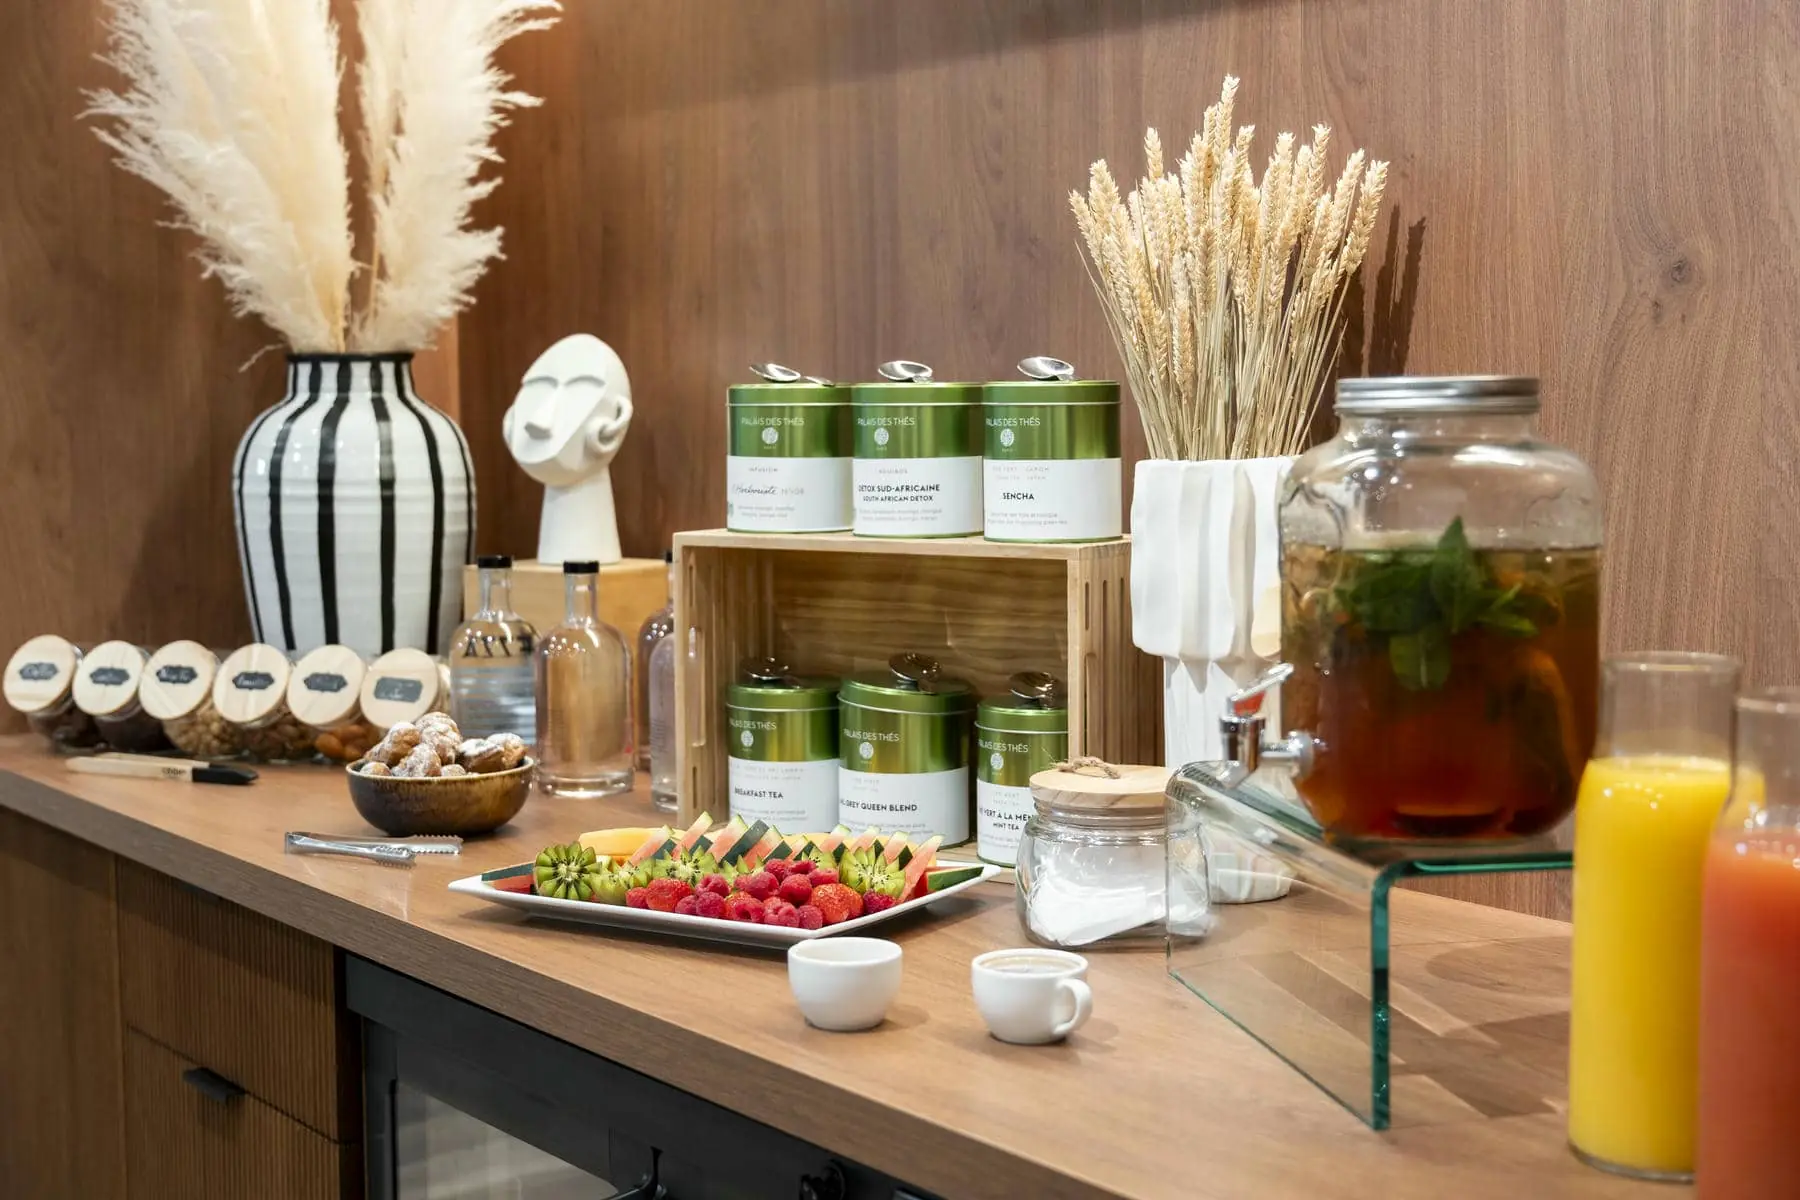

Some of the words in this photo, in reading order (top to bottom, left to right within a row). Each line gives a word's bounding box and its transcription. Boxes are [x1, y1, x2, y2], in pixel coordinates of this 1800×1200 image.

[765, 416, 782, 426] DES
[877, 416, 893, 426] DES
[893, 415, 915, 426] THÉS
[1003, 417, 1018, 427] DES
[1019, 416, 1041, 427] THÉS
[877, 483, 941, 493] SUD-AFRICAINE
[910, 494, 934, 502] DETOX
[1002, 492, 1035, 501] SENCHA
[862, 730, 877, 740] DES
[878, 731, 900, 742] THÉS
[993, 741, 1007, 752] DES
[1008, 742, 1029, 753] THÉS
[768, 791, 784, 799] TEA
[860, 802, 887, 811] QUEEN
[888, 804, 918, 812] BLEND
[1003, 812, 1013, 820] LA
